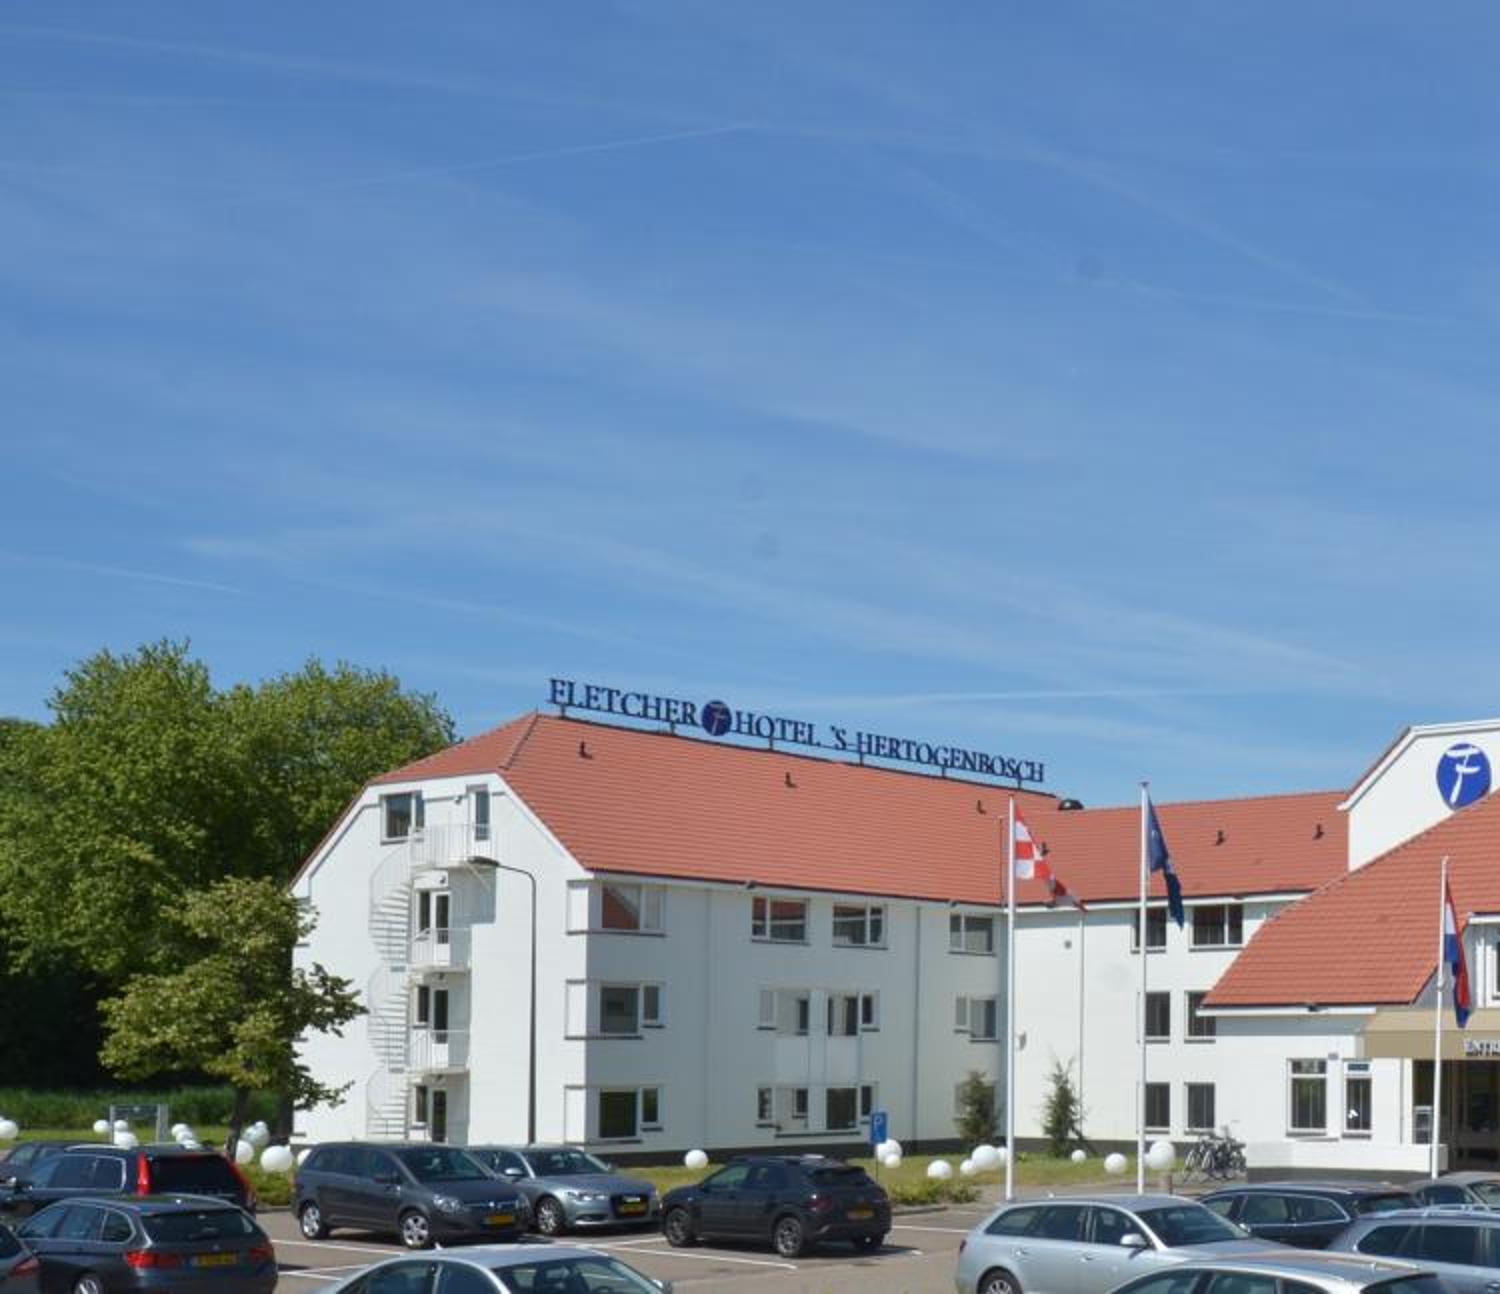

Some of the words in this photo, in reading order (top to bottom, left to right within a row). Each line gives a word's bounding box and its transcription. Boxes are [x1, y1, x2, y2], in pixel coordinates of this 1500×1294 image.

[549, 678, 699, 726] FLETCHER
[735, 709, 821, 746] HOTEL
[856, 731, 1045, 783] HERTOGENBOSCH
